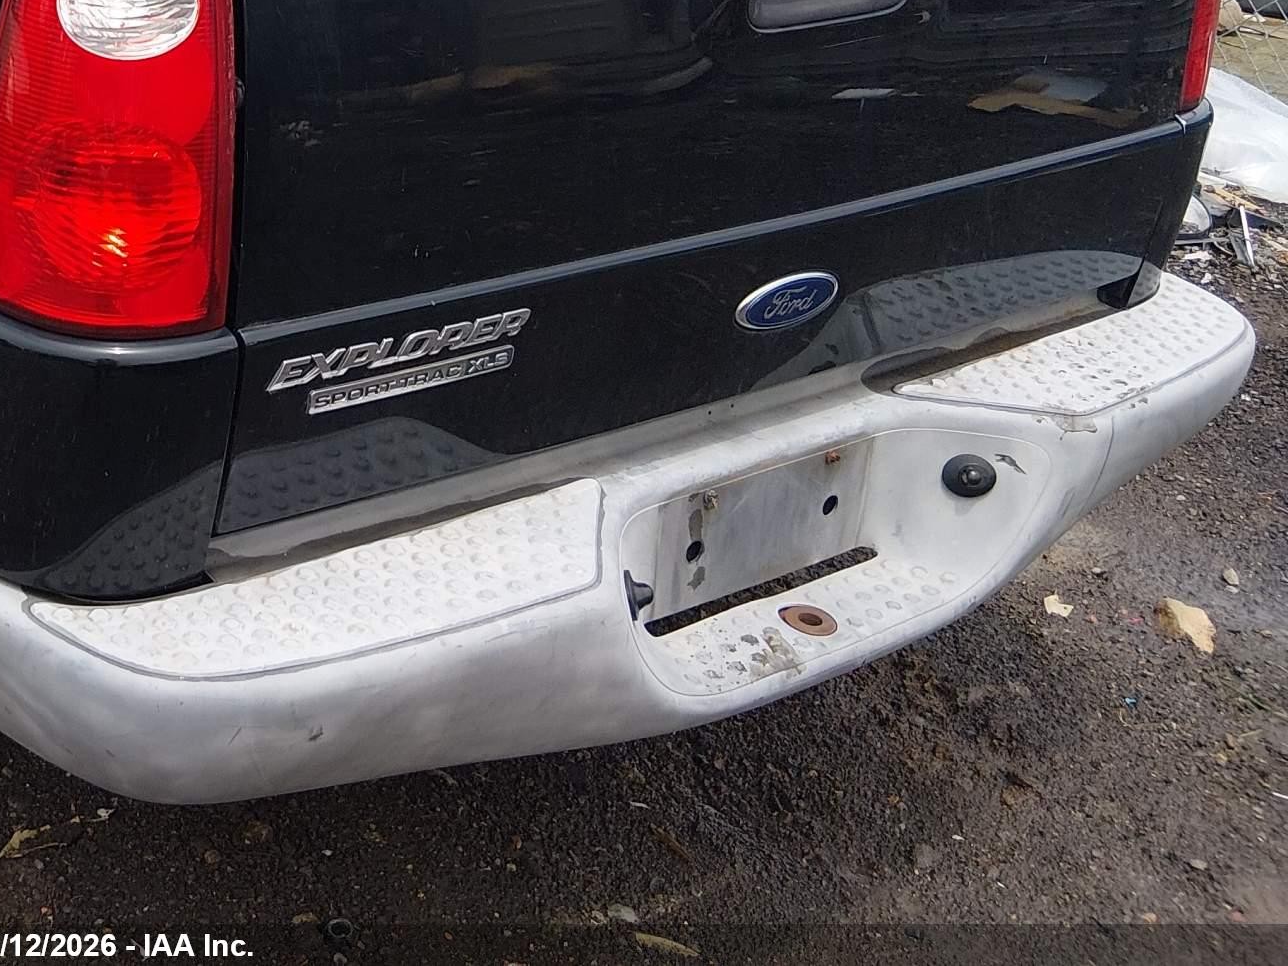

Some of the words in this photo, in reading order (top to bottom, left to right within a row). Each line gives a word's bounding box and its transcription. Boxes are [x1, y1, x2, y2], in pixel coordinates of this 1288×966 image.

[763, 285, 819, 320] Ford
[265, 308, 532, 393] EXPLORER
[468, 351, 508, 373] XLS
